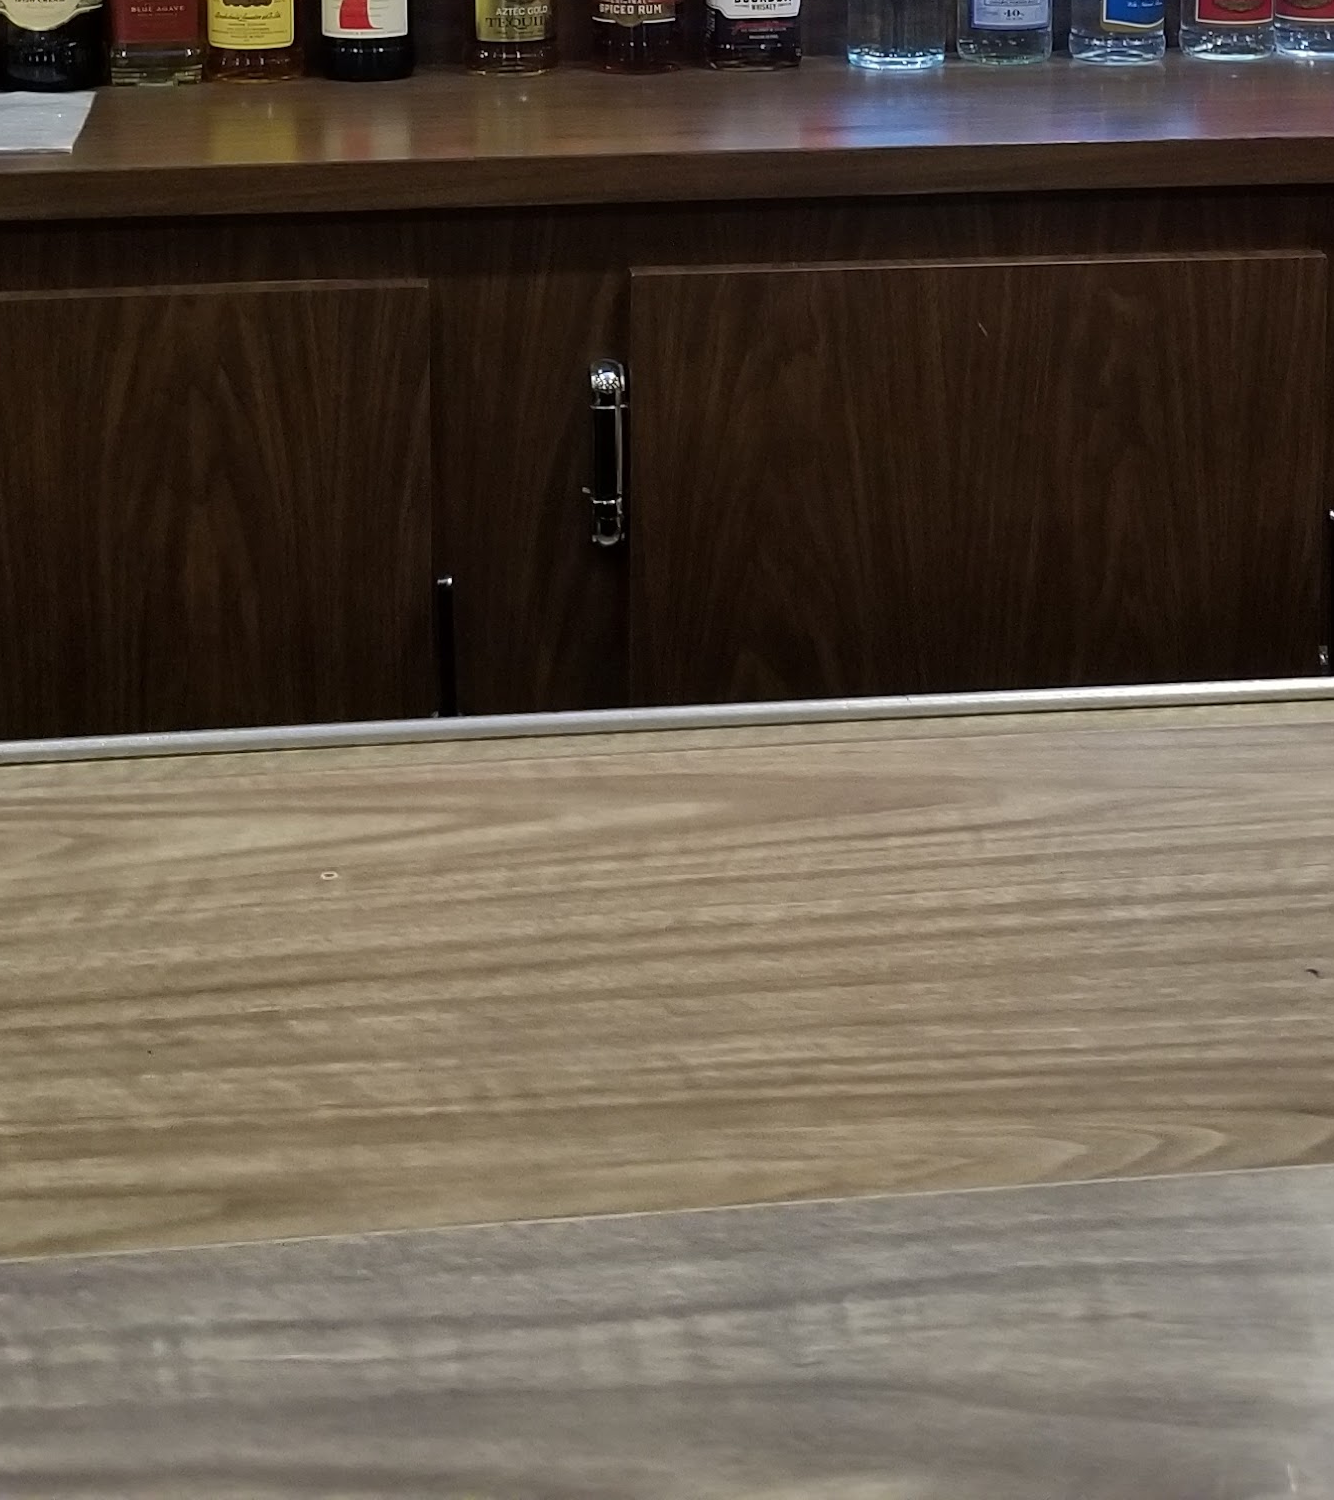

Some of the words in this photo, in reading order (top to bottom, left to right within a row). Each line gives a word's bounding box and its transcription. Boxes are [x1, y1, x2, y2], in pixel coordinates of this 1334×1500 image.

[130, 5, 153, 13] BLUE
[496, 6, 525, 16] AZTEC
[527, 5, 548, 15] GOLD
[599, 3, 634, 14] SPICED
[639, 3, 662, 14] RUM
[750, 2, 777, 12] WHISKEY
